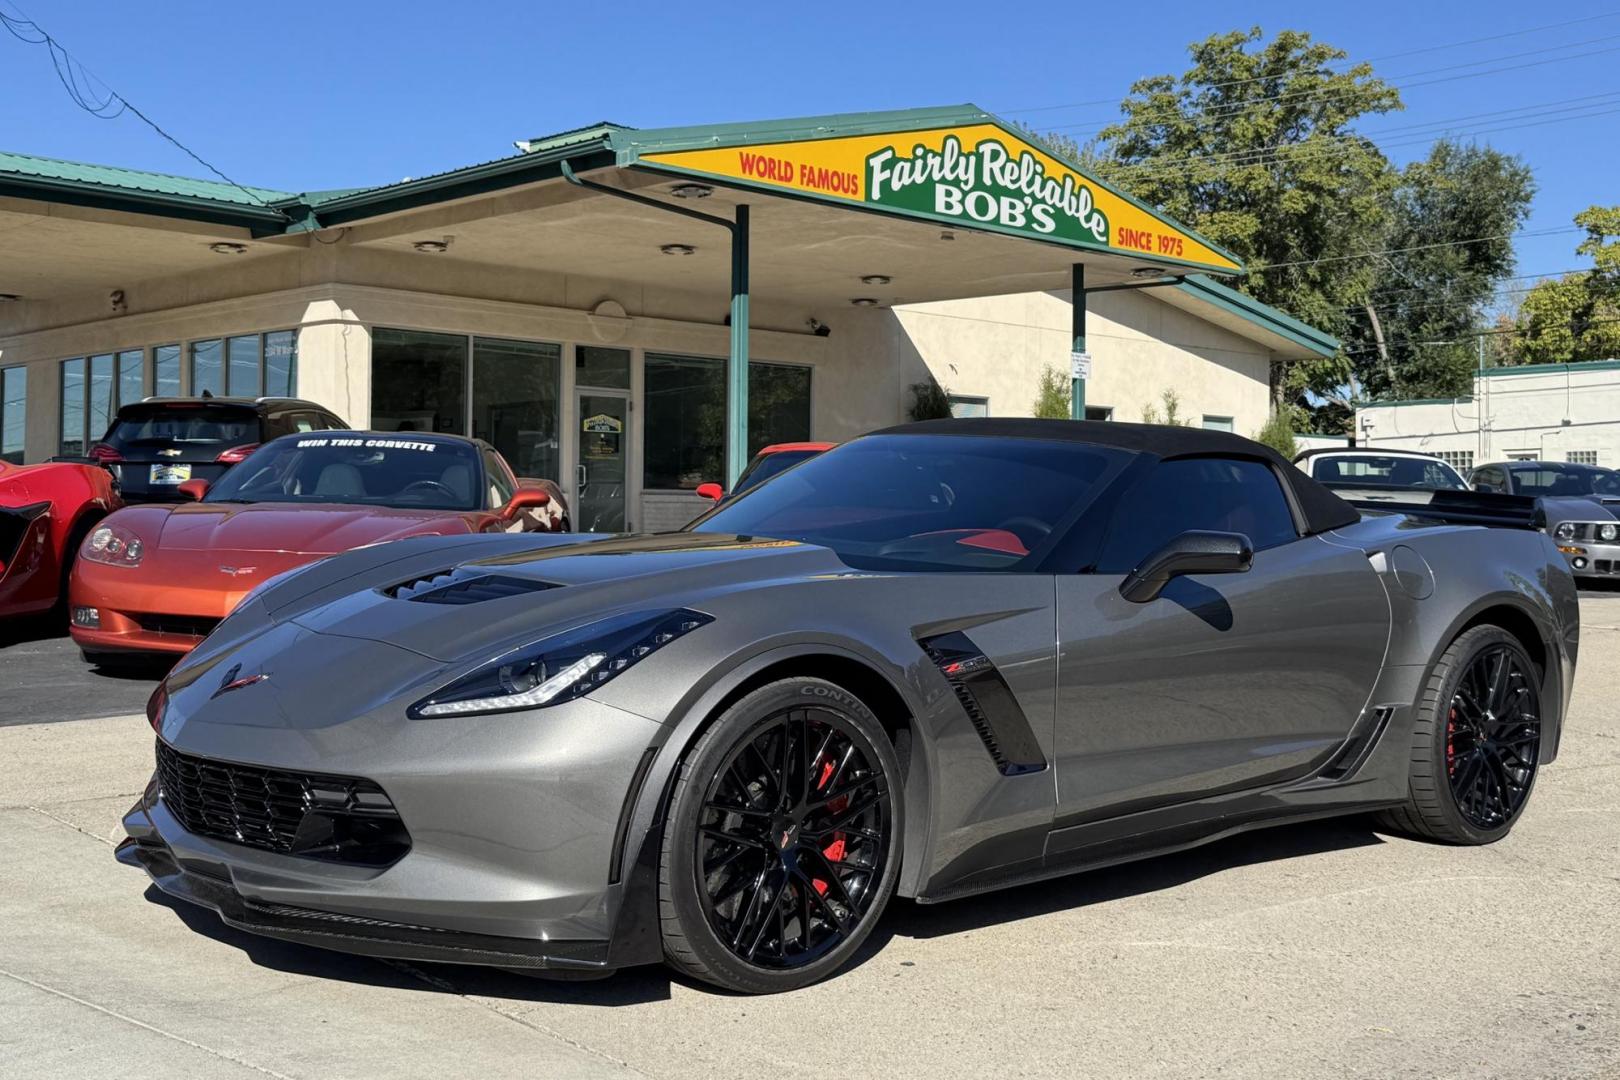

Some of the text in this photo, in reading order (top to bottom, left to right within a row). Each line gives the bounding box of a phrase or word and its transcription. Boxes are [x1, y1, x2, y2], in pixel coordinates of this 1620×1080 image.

[739, 151, 859, 195] WORLD FAMOUS
[869, 138, 1107, 242] Fairly Reliable
[935, 183, 1056, 233] BOB'S
[1118, 227, 1184, 256] SINCE 1975
[297, 439, 436, 452] WIN THIS CORVETTE
